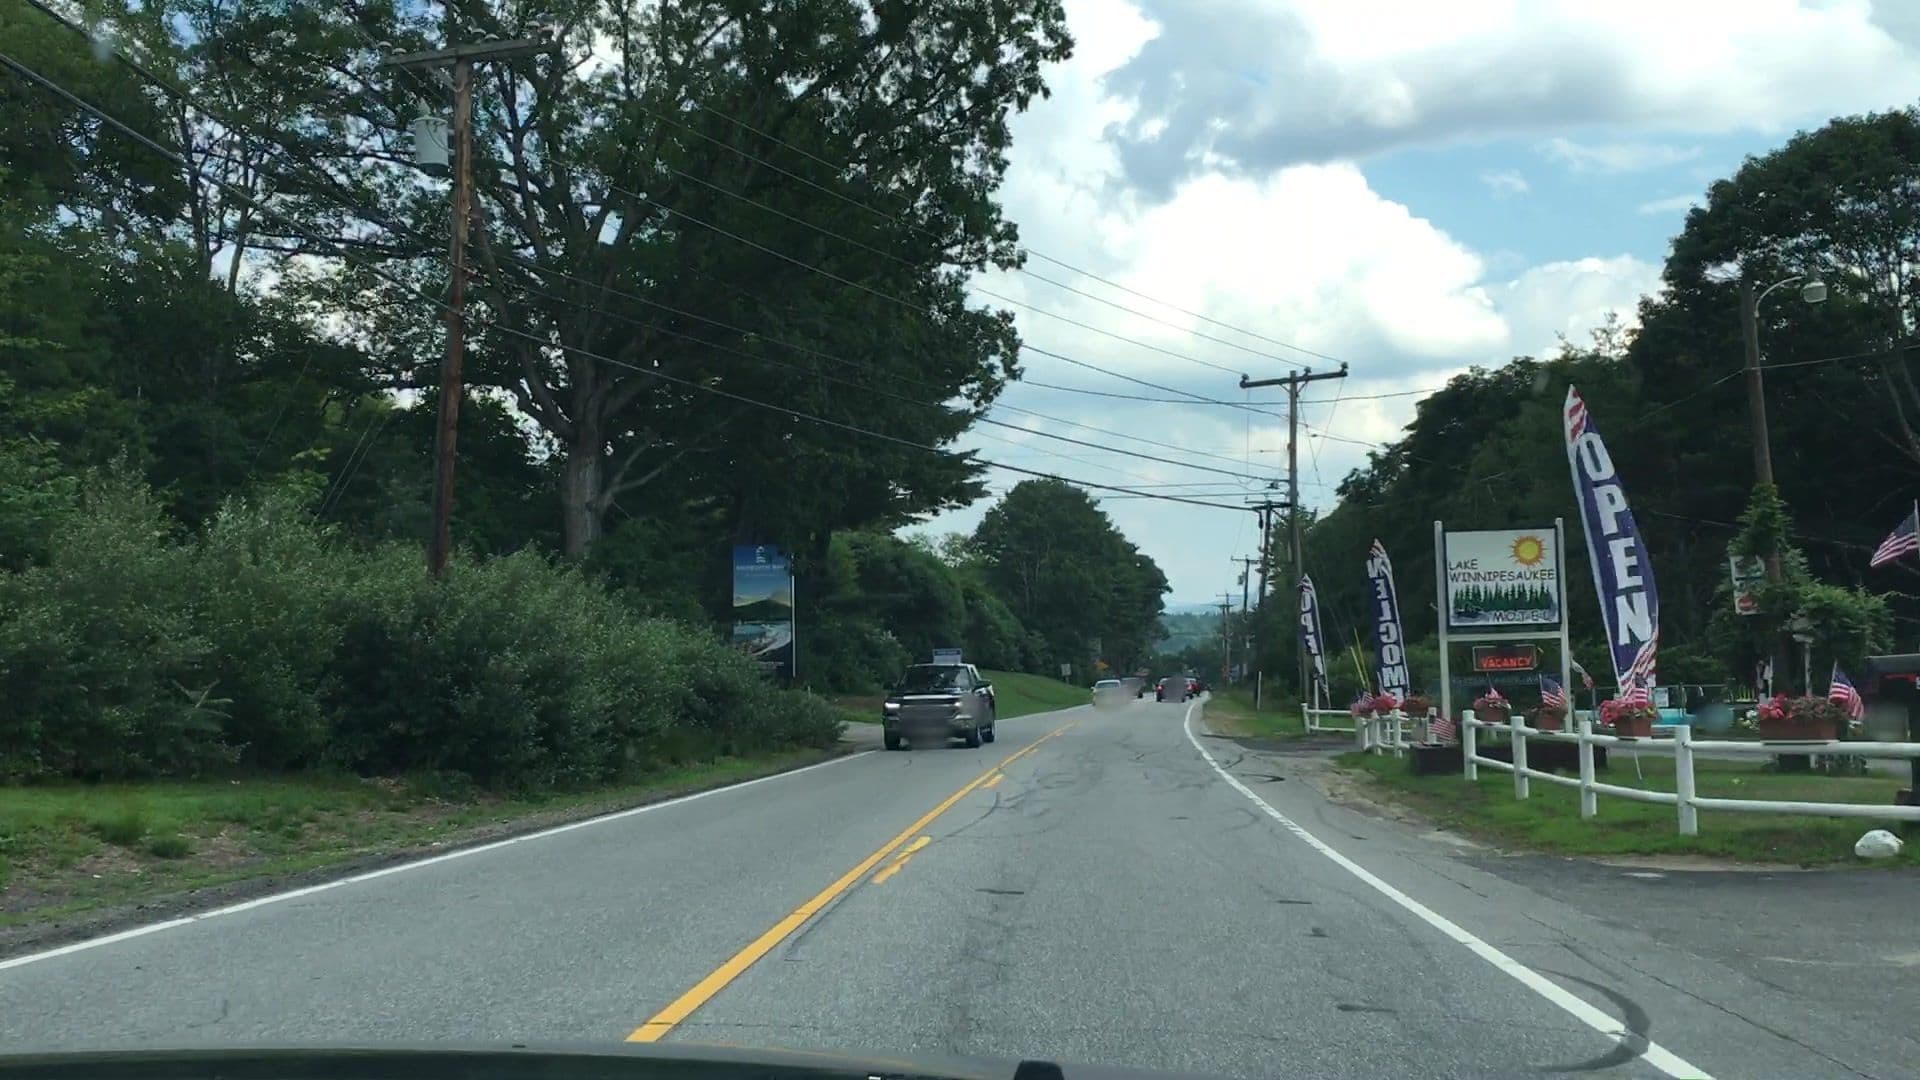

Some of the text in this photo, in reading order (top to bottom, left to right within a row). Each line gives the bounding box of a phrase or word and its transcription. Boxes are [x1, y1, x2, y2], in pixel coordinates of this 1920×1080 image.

[1577, 432, 1652, 645] OPEN
[1449, 558, 1478, 571] LAKE
[1450, 569, 1555, 582] WINNIPESAUKEE
[1492, 609, 1553, 622] MOTEL
[1481, 656, 1532, 668] VACANCY
